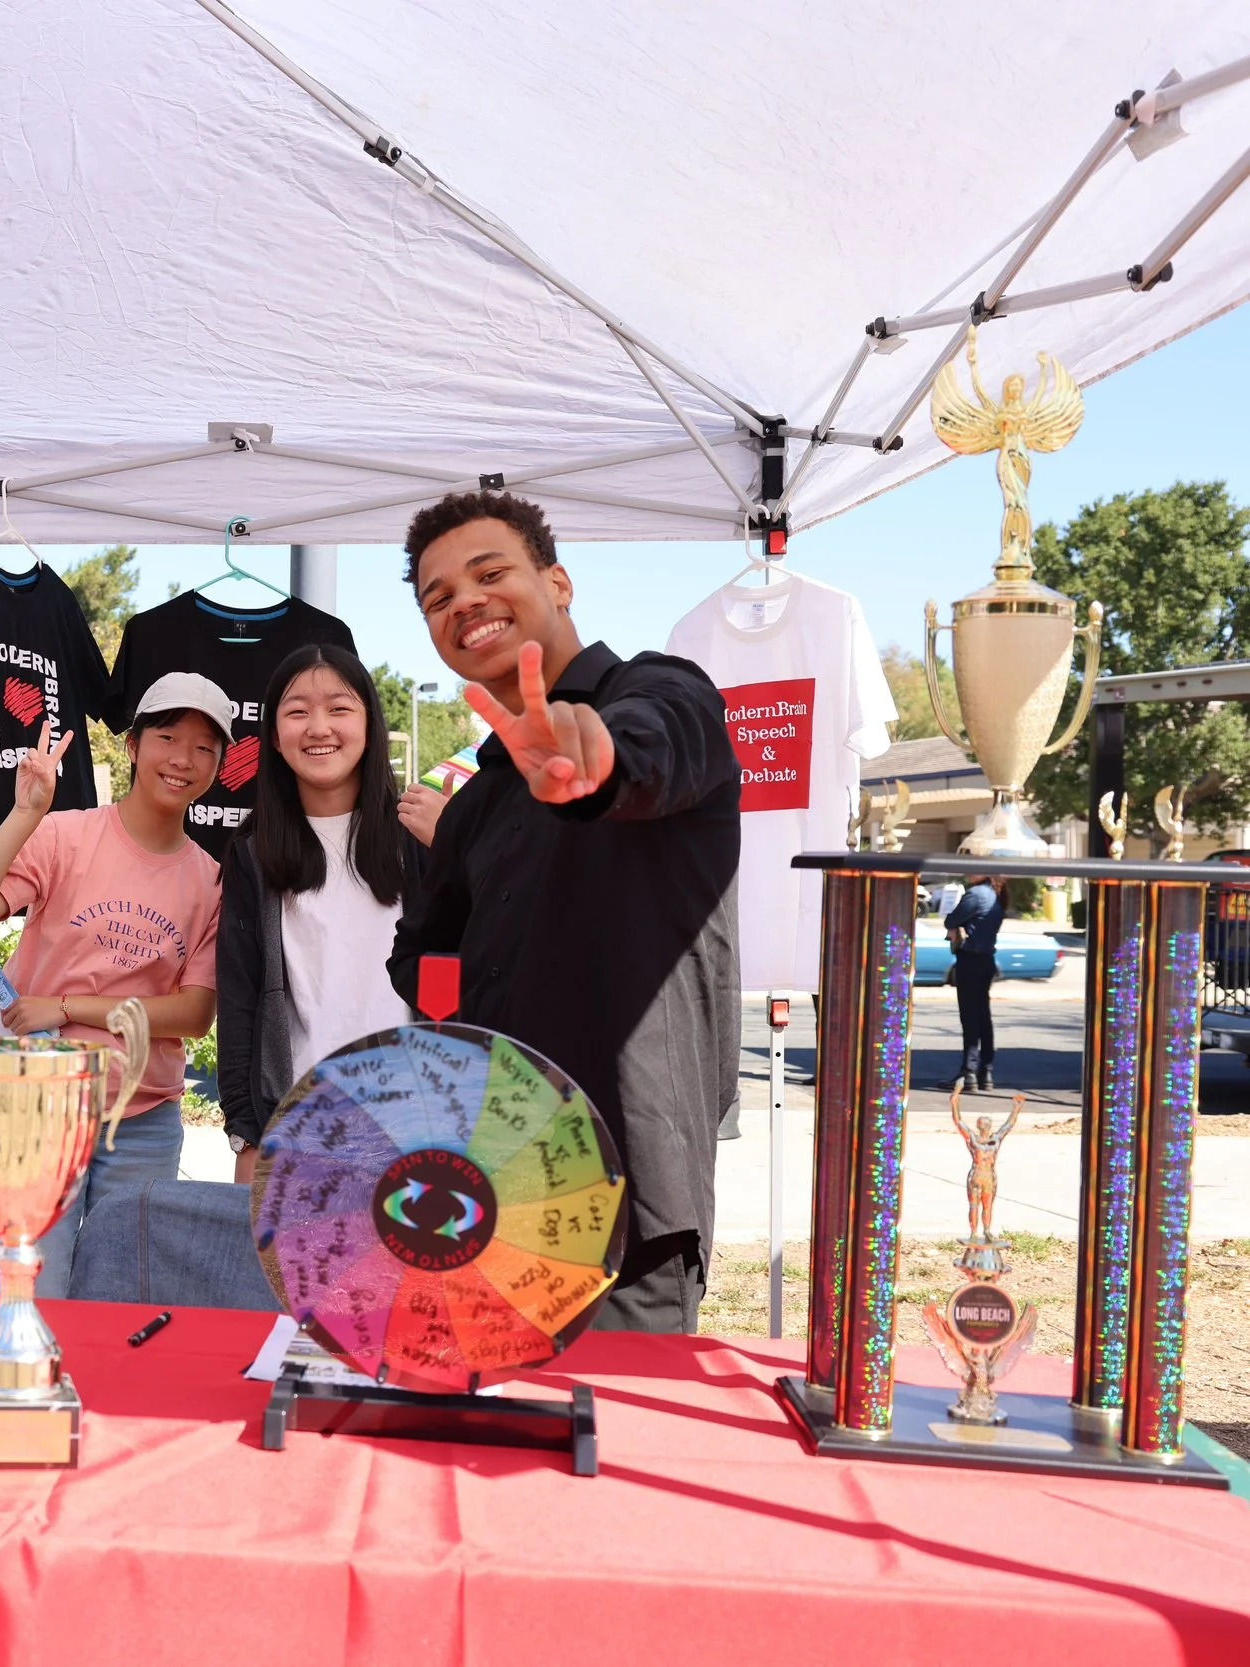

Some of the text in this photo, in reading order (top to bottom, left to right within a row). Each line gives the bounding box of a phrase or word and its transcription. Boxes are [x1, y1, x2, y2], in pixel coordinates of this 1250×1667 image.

[737, 722, 796, 744] Speech
[761, 745, 777, 761] &
[740, 767, 797, 784] Debate
[69, 900, 187, 959] WITCH MIRROR
[105, 919, 166, 946] THE CAT
[94, 934, 166, 961] NAUGHTY
[387, 1151, 483, 1186] SPIN TO WIN
[538, 1208, 561, 1247] Dogs
[385, 1233, 480, 1268] SPIN TO WIN
[955, 1306, 1011, 1322] LONG BEACH
